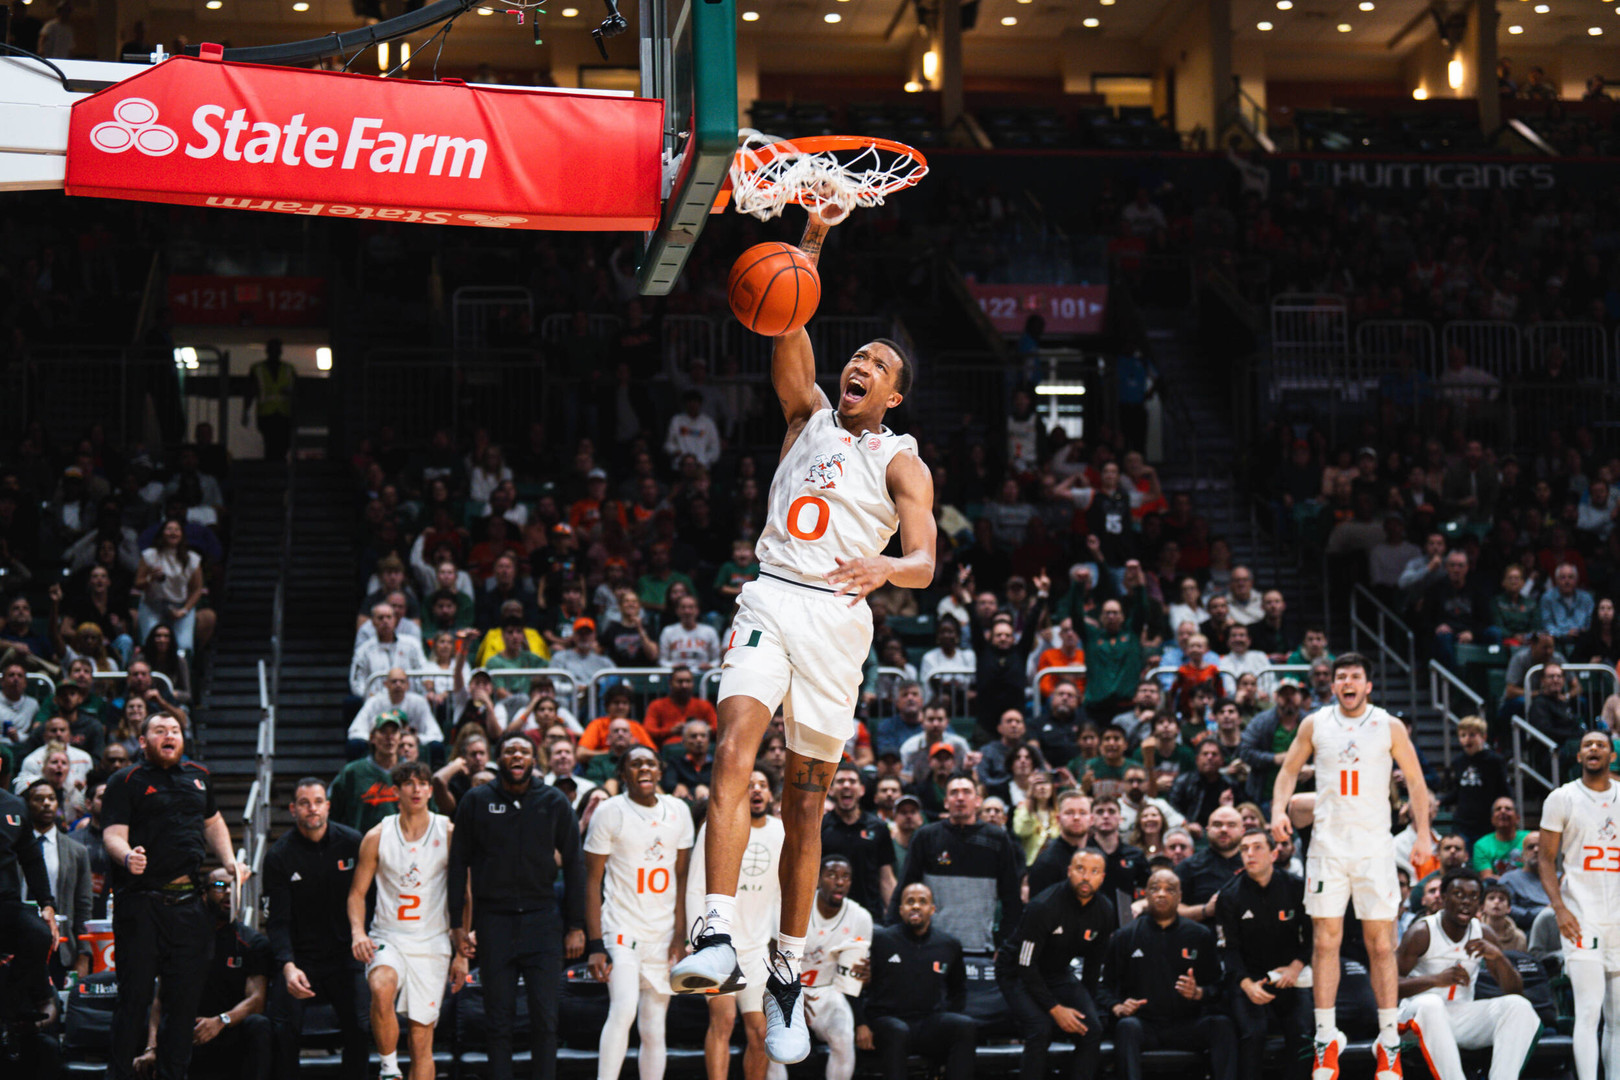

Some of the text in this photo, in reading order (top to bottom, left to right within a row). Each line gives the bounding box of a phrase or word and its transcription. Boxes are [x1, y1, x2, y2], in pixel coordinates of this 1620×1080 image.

[191, 288, 305, 311] 121 122
[1051, 298, 1086, 319] 101
[787, 496, 830, 541] 0
[1340, 770, 1359, 796] 11
[1583, 846, 1620, 872] 23
[637, 867, 670, 894] 10
[397, 894, 420, 921] 2
